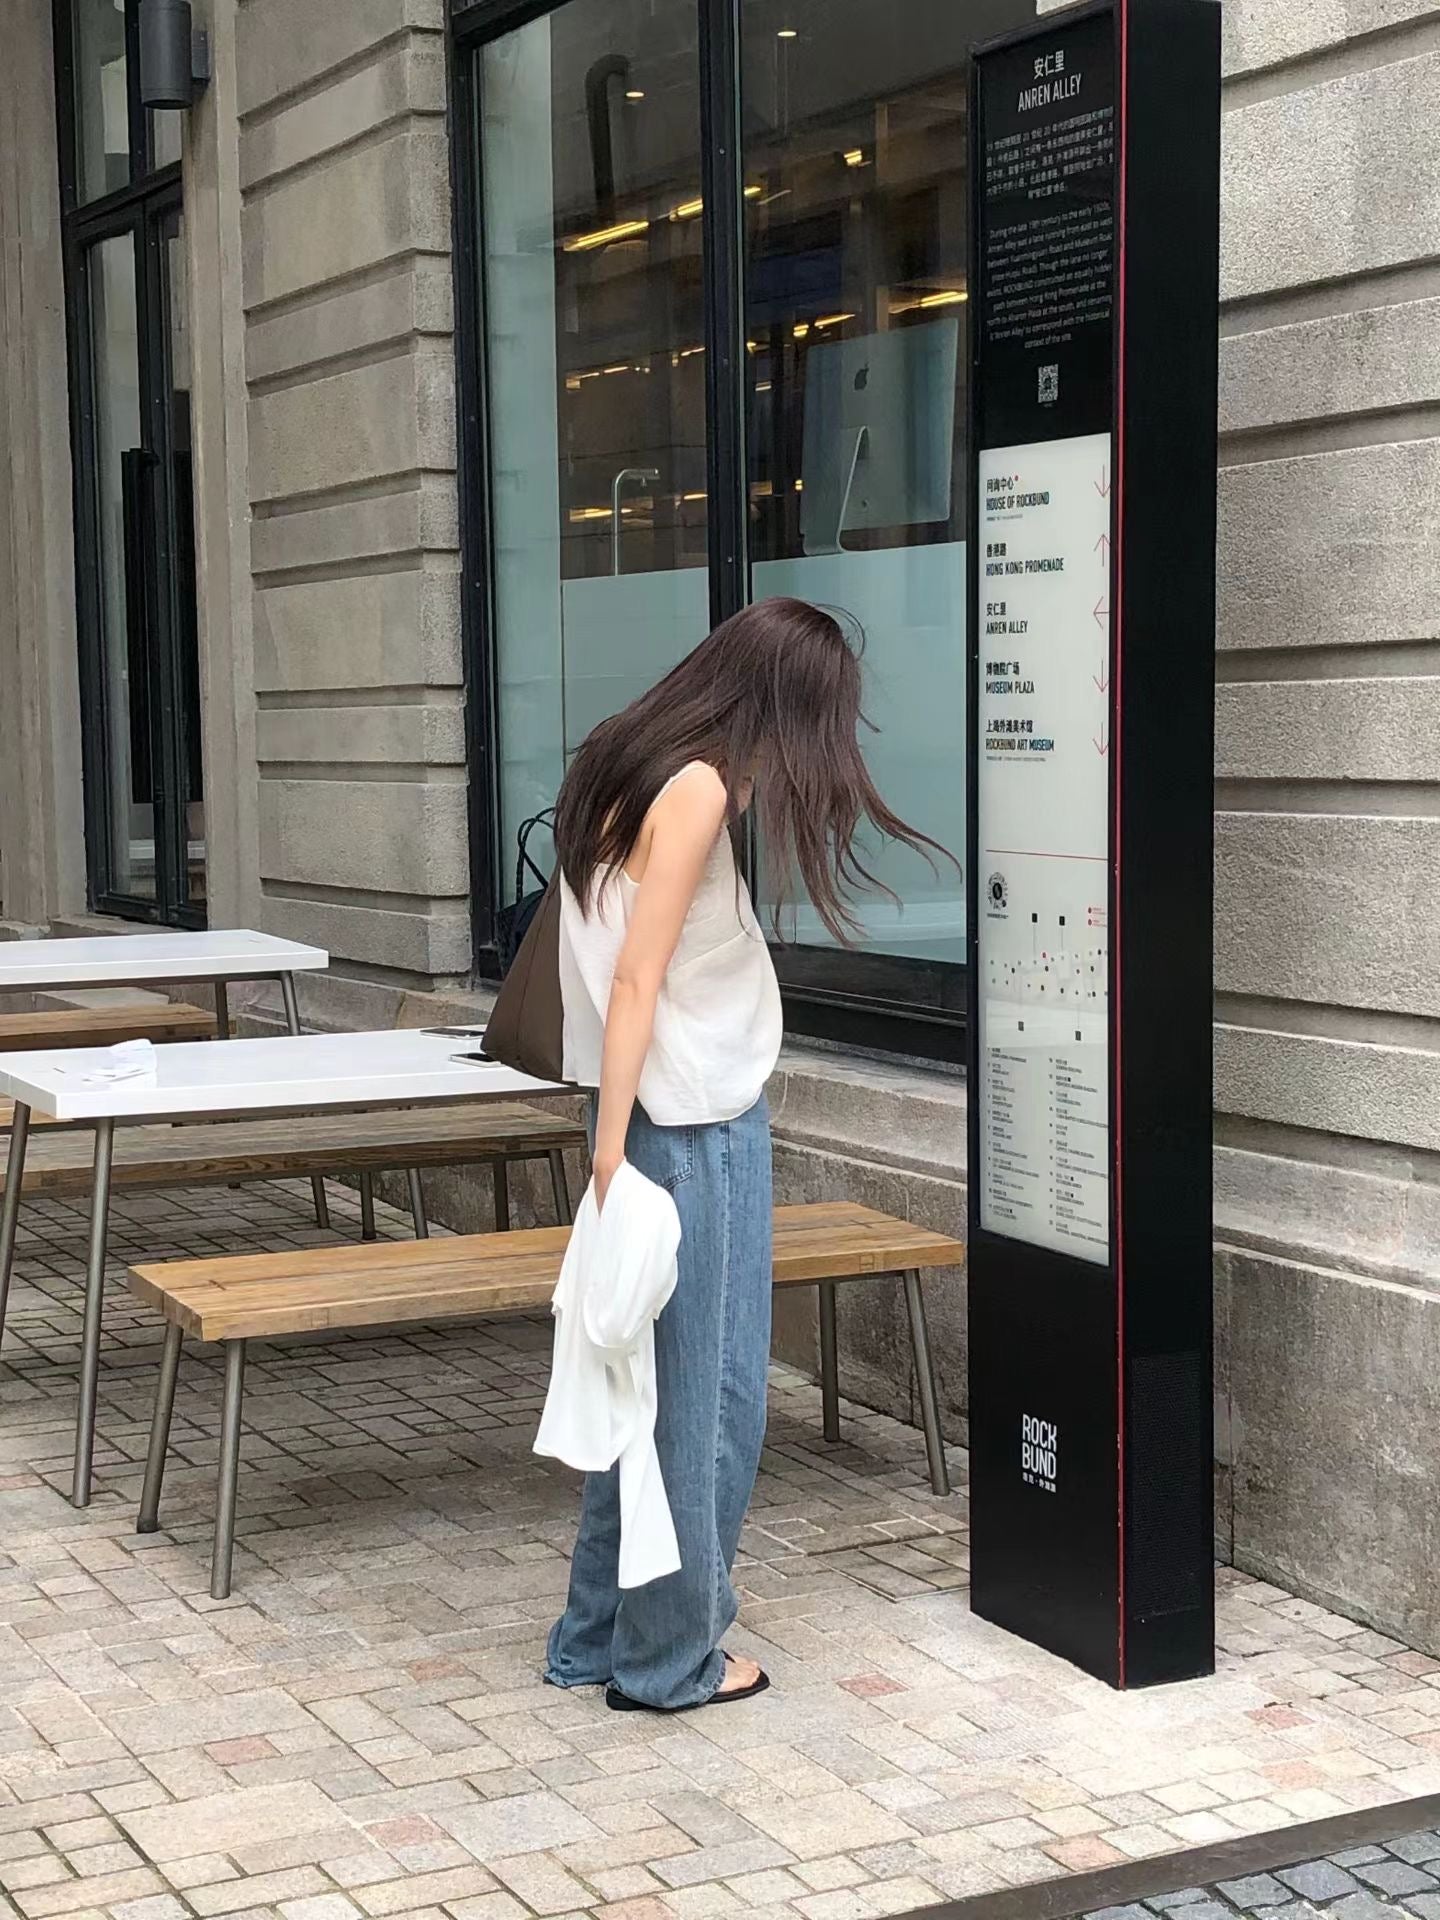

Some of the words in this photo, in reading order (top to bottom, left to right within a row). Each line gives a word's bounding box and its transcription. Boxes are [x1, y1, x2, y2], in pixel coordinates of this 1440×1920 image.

[1034, 50, 1064, 79] 安仁里
[1018, 83, 1050, 112] ANREN
[1052, 73, 1081, 101] ALLEY
[986, 476, 1014, 493] 问询中心
[986, 496, 1006, 511] HOUSE
[1007, 495, 1015, 509] OF
[1016, 491, 1050, 508] ROCKBUND
[986, 562, 1003, 576] HONG
[1005, 561, 1023, 575] KONG
[1025, 557, 1064, 573] PROMENADE
[986, 602, 1006, 617] 安仁里
[986, 621, 1007, 634] ANREN
[1008, 620, 1028, 634] ALLEY
[986, 661, 1020, 676] 博物院广场
[986, 681, 1013, 694] MUSEUM
[1015, 681, 1035, 694] PLAZA
[986, 738, 1016, 751] ROCKBUND
[1017, 738, 1028, 750] ART
[1029, 738, 1055, 751] MUSEUM
[1022, 1413, 1057, 1452] ROCK
[1022, 1441, 1057, 1480] BUND
